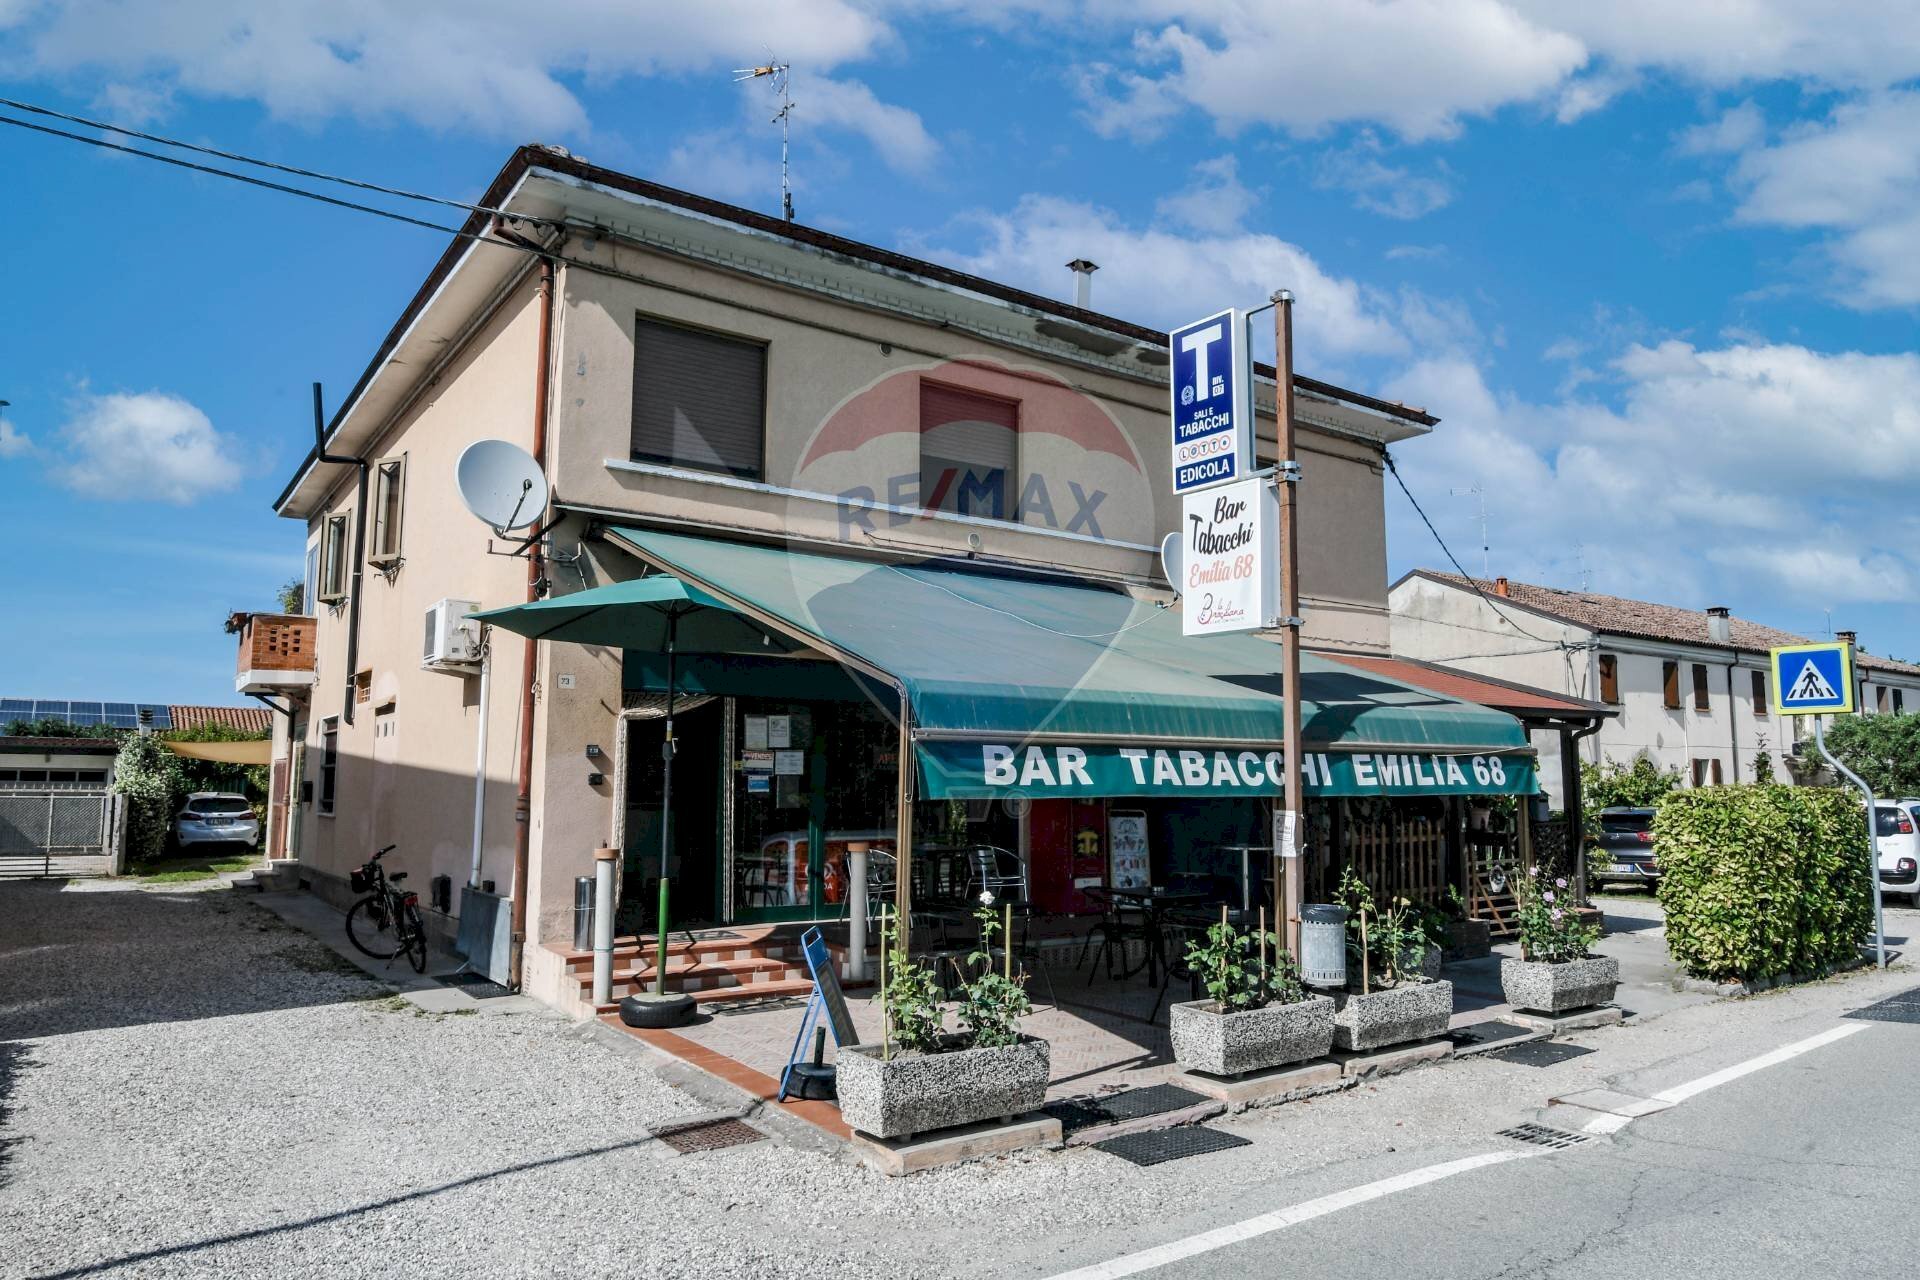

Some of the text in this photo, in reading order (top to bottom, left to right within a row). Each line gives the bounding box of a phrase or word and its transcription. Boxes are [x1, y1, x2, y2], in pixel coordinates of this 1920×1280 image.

[1182, 323, 1222, 402] T
[1179, 412, 1229, 438] TABACCHI
[1193, 407, 1214, 420] SALI E
[1179, 435, 1231, 461] LOTTO
[1180, 459, 1230, 484] EDICOLA
[1213, 496, 1246, 524] Bar
[1189, 514, 1253, 555] Tabacchi
[1189, 553, 1254, 589] Emilia 68
[982, 744, 1506, 788] BAR TABACCHI EMILIA 68
